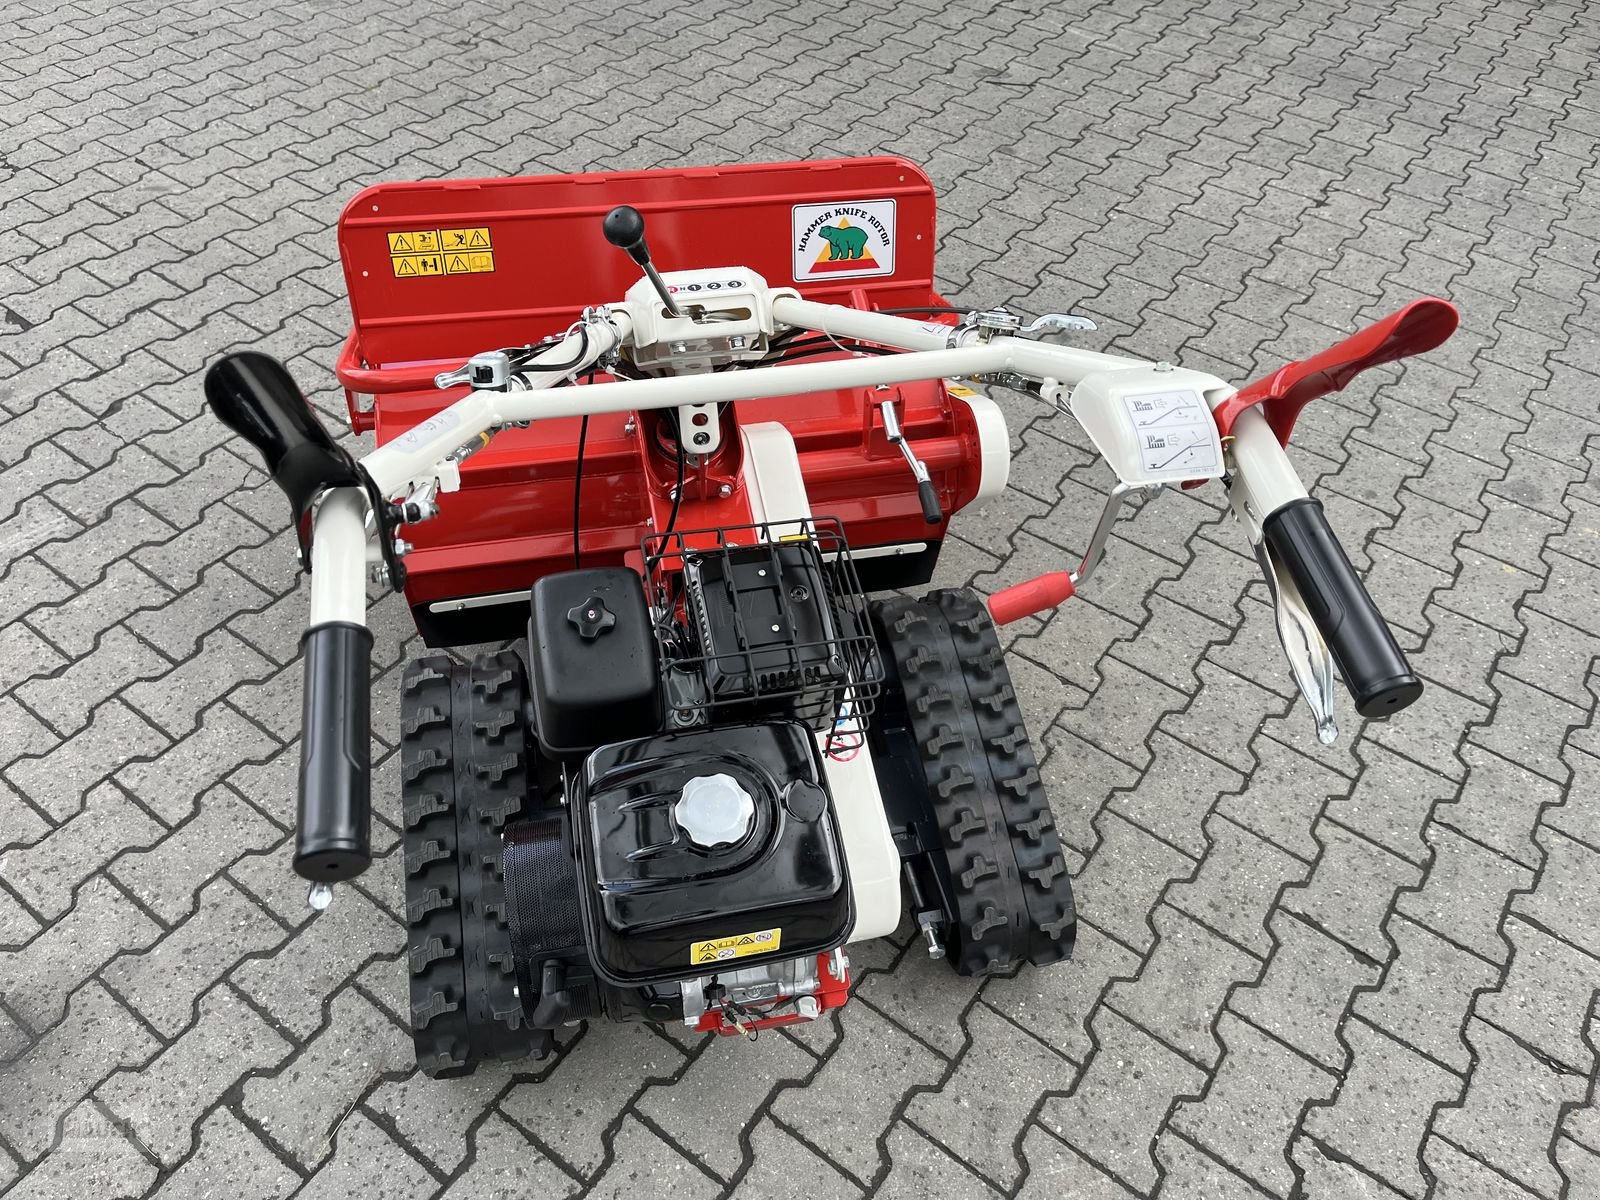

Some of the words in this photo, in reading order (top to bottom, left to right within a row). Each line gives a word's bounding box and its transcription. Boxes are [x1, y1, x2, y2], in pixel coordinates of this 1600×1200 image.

[798, 211, 833, 252] HAMMER
[834, 207, 868, 219] KNIFE
[868, 215, 891, 247] ROTOR
